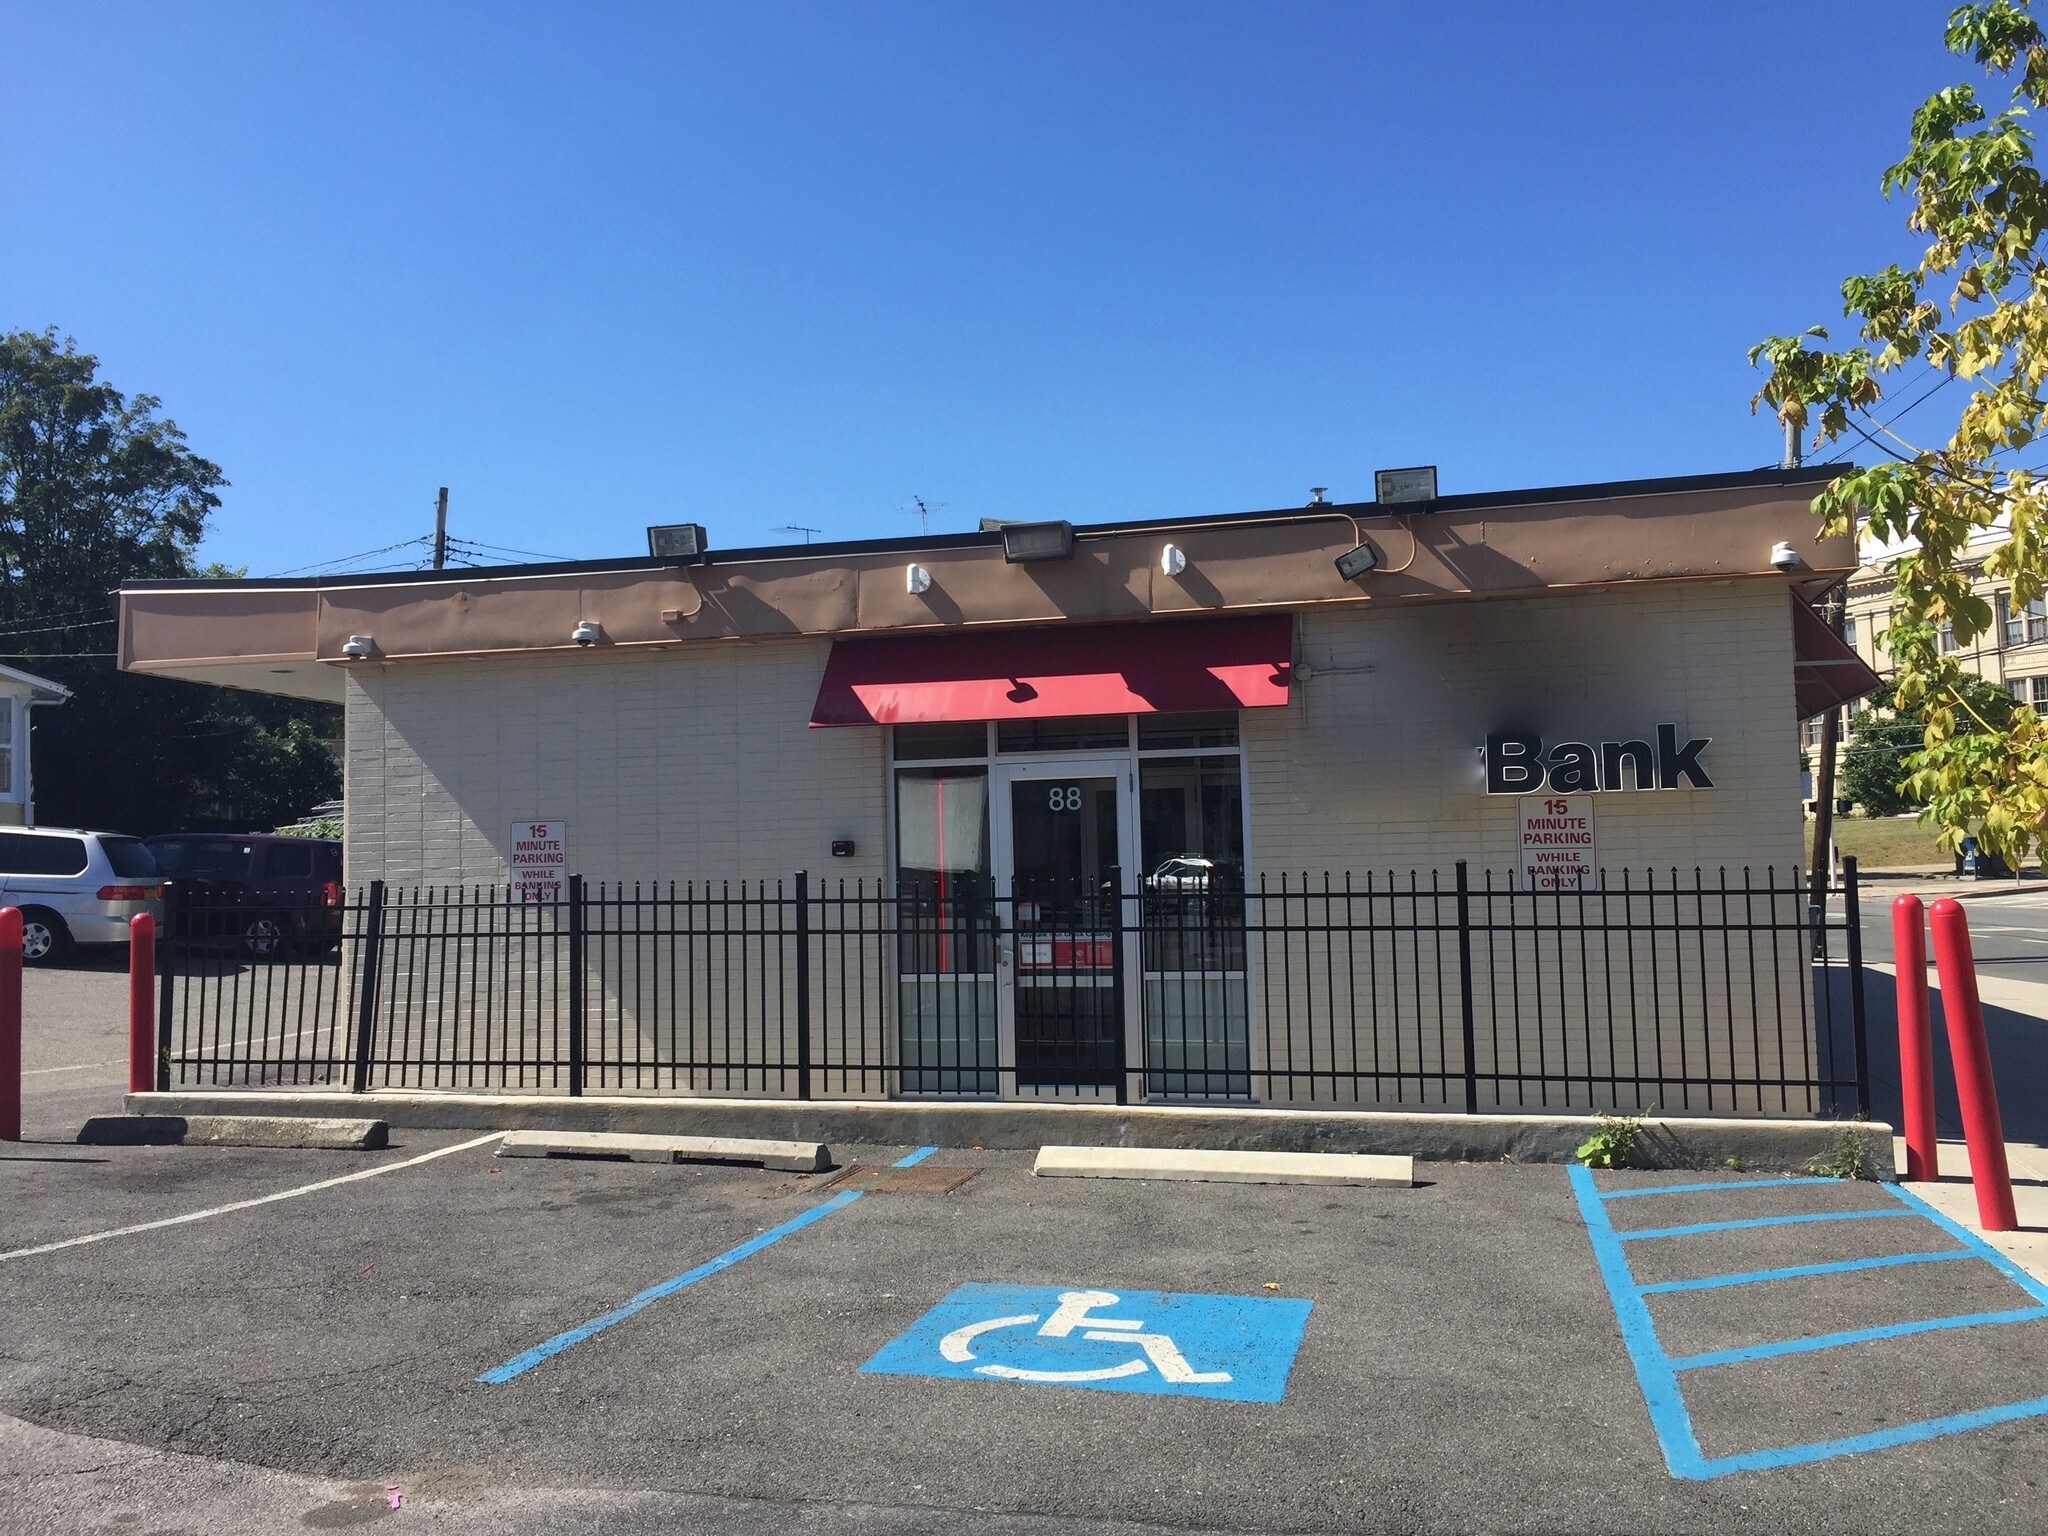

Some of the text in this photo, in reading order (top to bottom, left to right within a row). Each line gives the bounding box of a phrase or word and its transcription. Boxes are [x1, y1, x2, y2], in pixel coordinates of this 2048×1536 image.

[1484, 722, 1715, 795] Bank
[1049, 786, 1082, 811] 88
[1544, 799, 1568, 815] 15
[1527, 818, 1586, 830] MINUTE
[529, 825, 547, 838] 15
[1523, 832, 1592, 845] PARKING
[516, 840, 560, 851] MINUTE
[513, 853, 563, 864] PARKING
[1536, 852, 1580, 862] WHILE
[522, 870, 555, 879] WHILE
[1527, 864, 1590, 875] BANKING
[1020, 931, 1047, 939] Keyank
